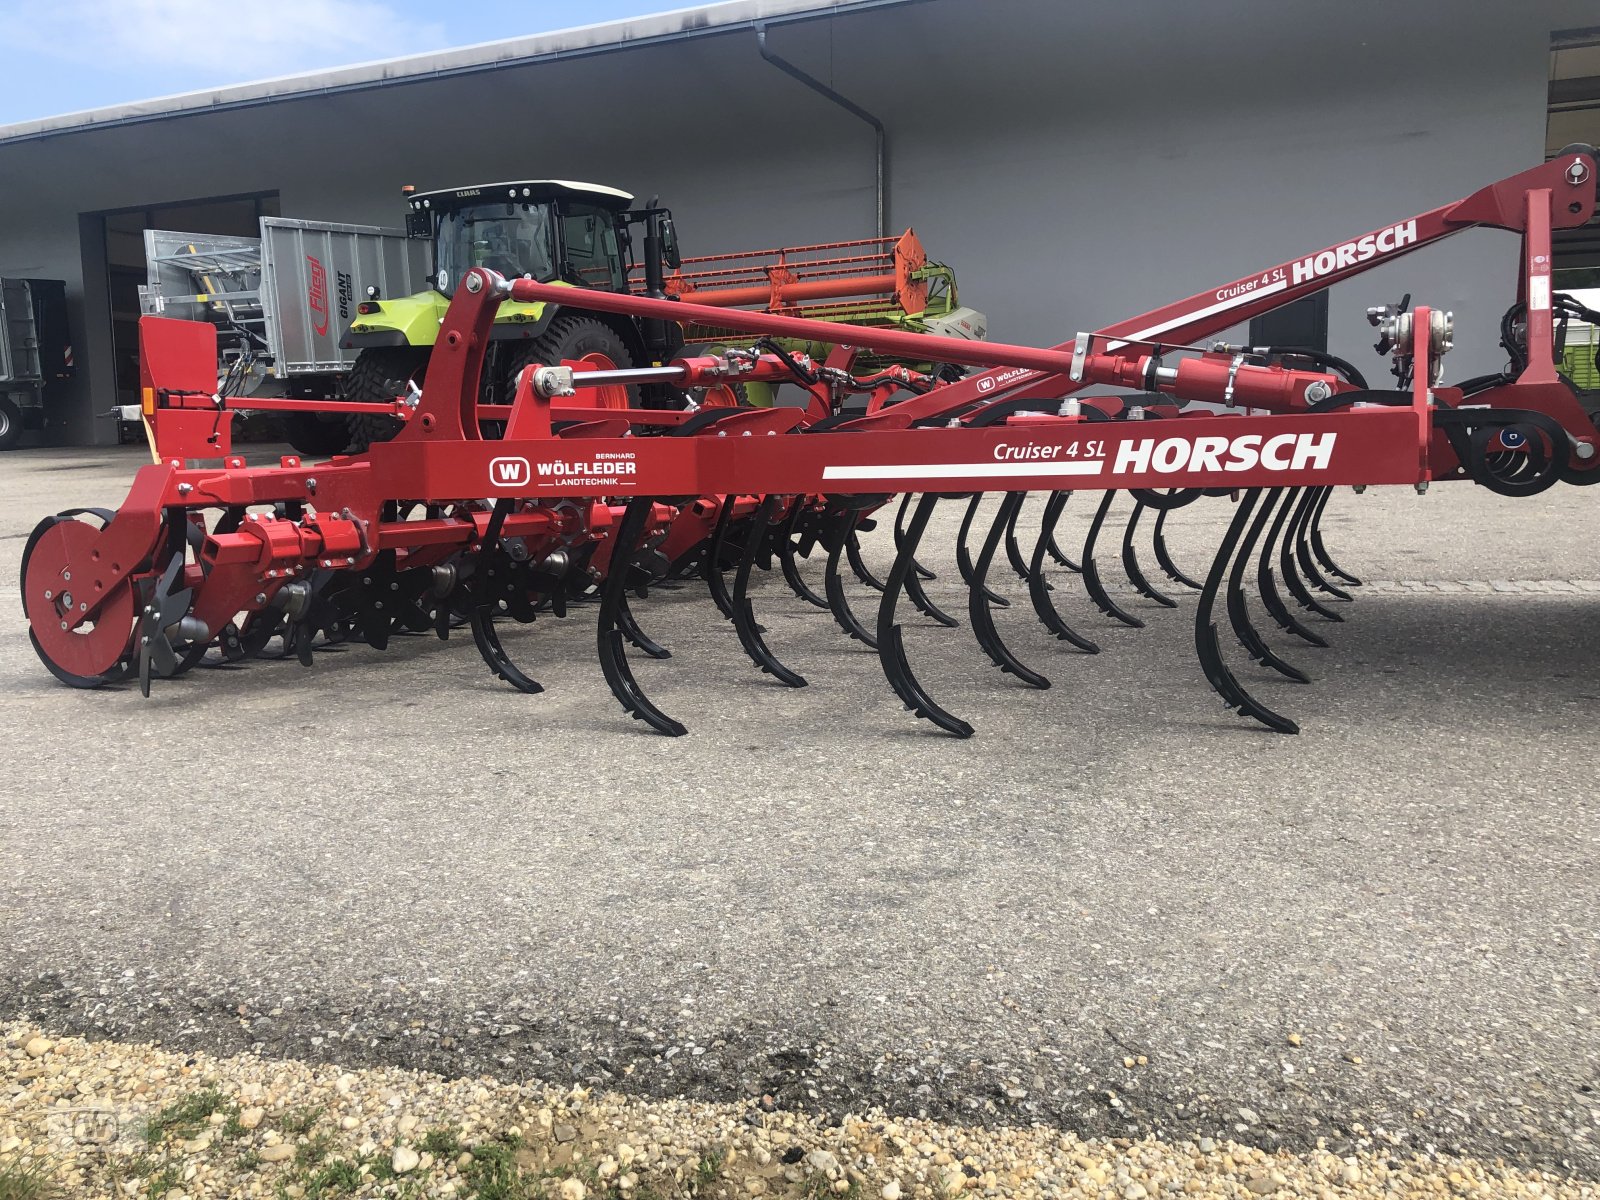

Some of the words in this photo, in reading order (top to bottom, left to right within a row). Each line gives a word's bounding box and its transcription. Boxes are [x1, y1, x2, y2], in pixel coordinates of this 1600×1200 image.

[456, 189, 481, 198] CLAAS
[1215, 277, 1259, 302] Cruiser
[1261, 273, 1271, 287] 4
[1272, 268, 1287, 283] SL
[1292, 219, 1418, 285] HORSCH
[306, 255, 326, 313] Fliegl
[337, 270, 348, 319] GIGANT
[595, 452, 636, 460] BERNHARD
[993, 441, 1063, 461] Cruiser
[1066, 441, 1078, 458] 4
[1084, 440, 1107, 458] SL
[1112, 432, 1337, 474] HORSCH
[498, 463, 520, 480] W
[537, 459, 636, 476] WÖLFLEDER
[555, 477, 619, 486] LANDTECHNIK
